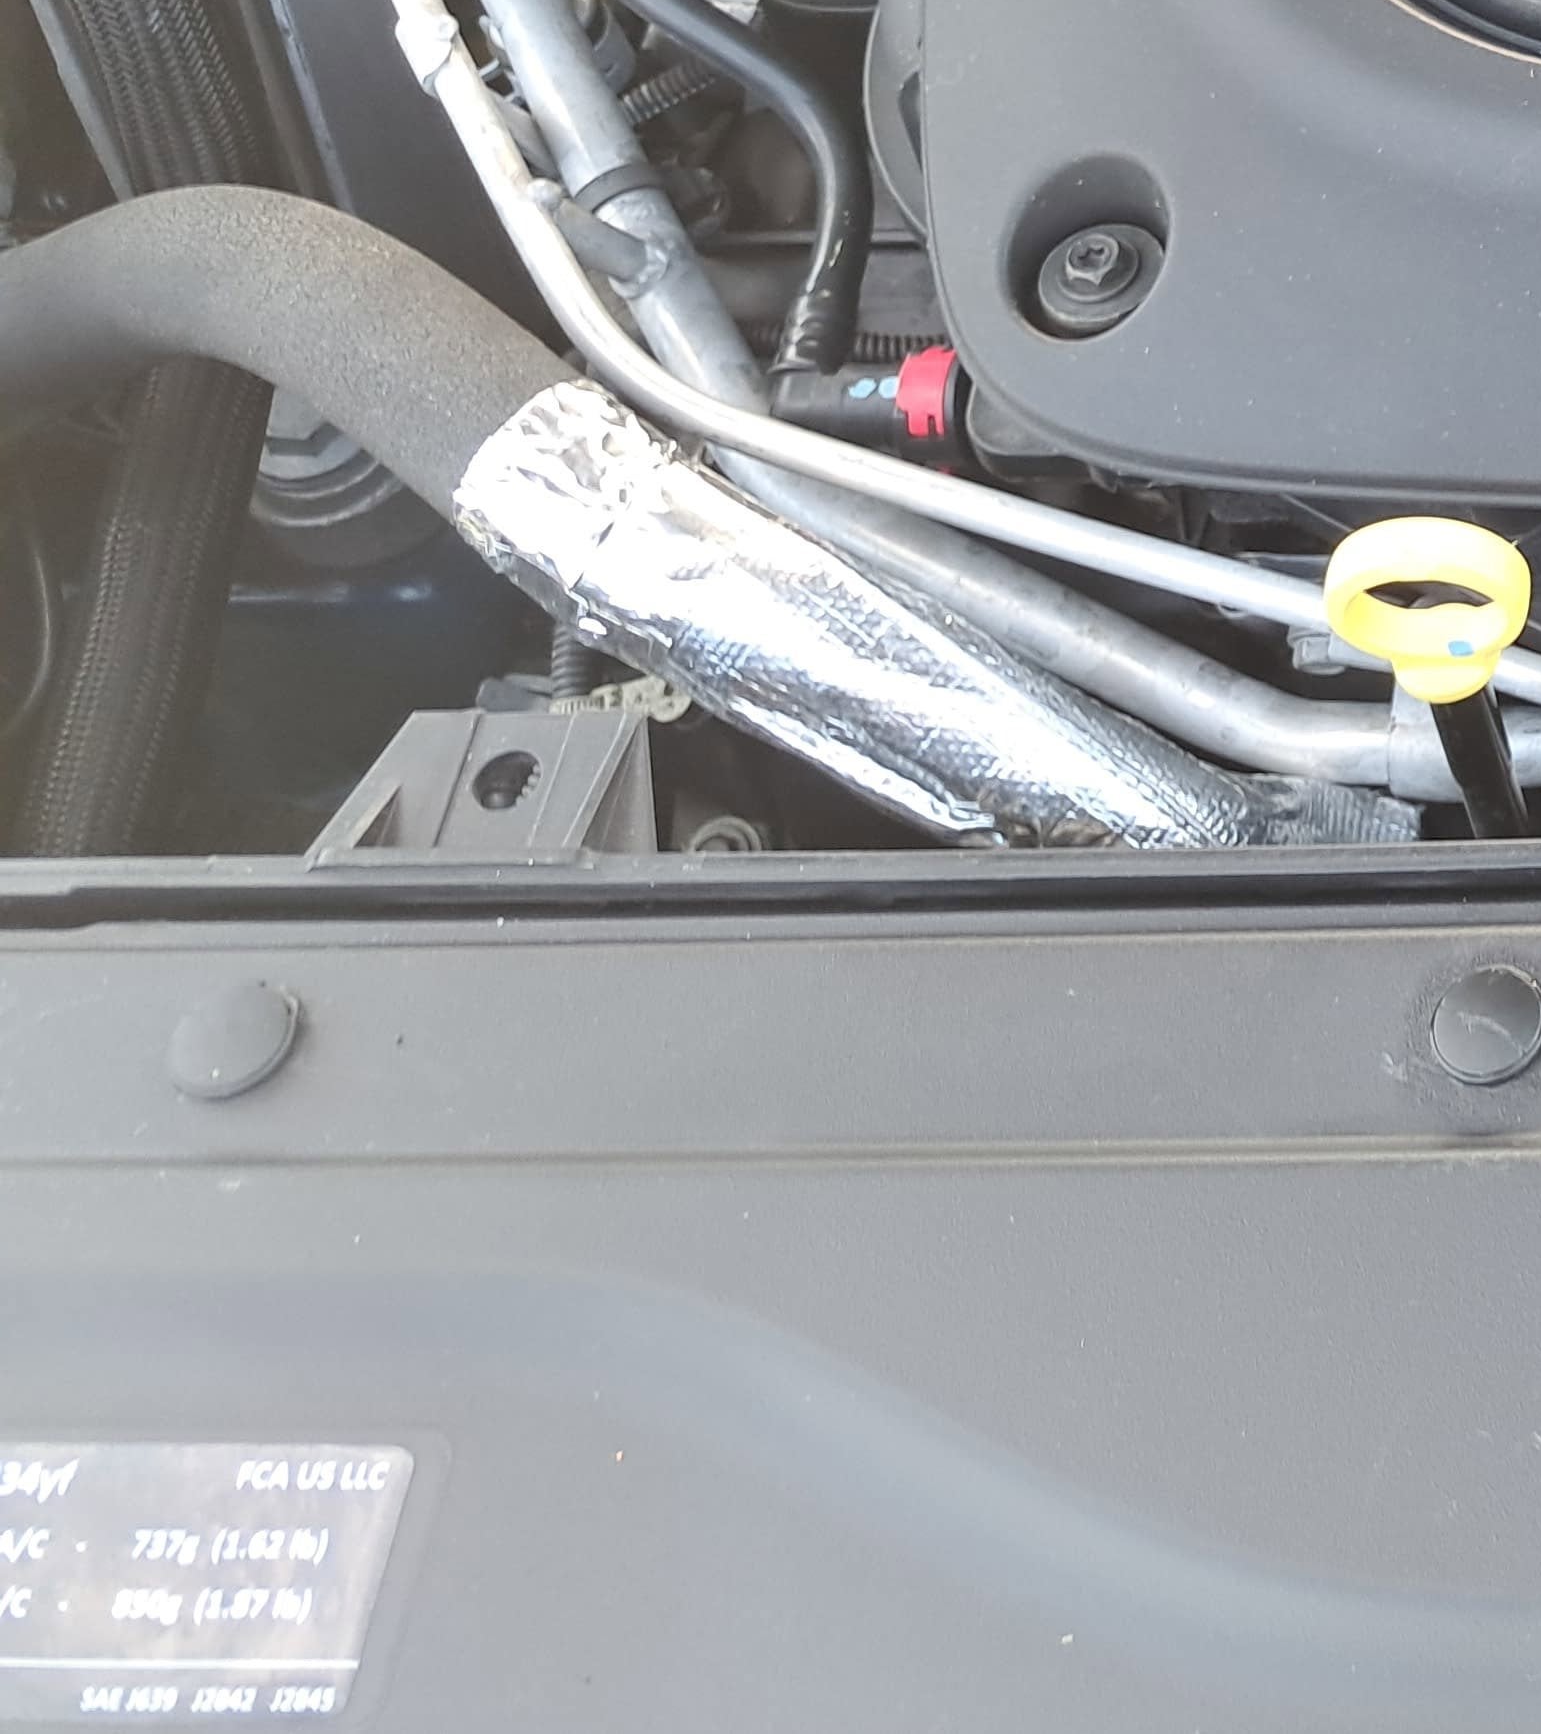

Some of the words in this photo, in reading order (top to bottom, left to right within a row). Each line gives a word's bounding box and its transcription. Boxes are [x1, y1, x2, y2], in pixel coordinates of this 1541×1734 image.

[0, 1458, 80, 1504] 34yf
[235, 1460, 290, 1491] FCA
[296, 1460, 337, 1491] US
[340, 1460, 391, 1491] LLC
[131, 1528, 201, 1566] 737g
[210, 1527, 285, 1566] (1.62
[288, 1527, 329, 1566] lb)
[0, 1585, 32, 1620] /C
[271, 1588, 313, 1626] lb)
[80, 1686, 124, 1713] SAE
